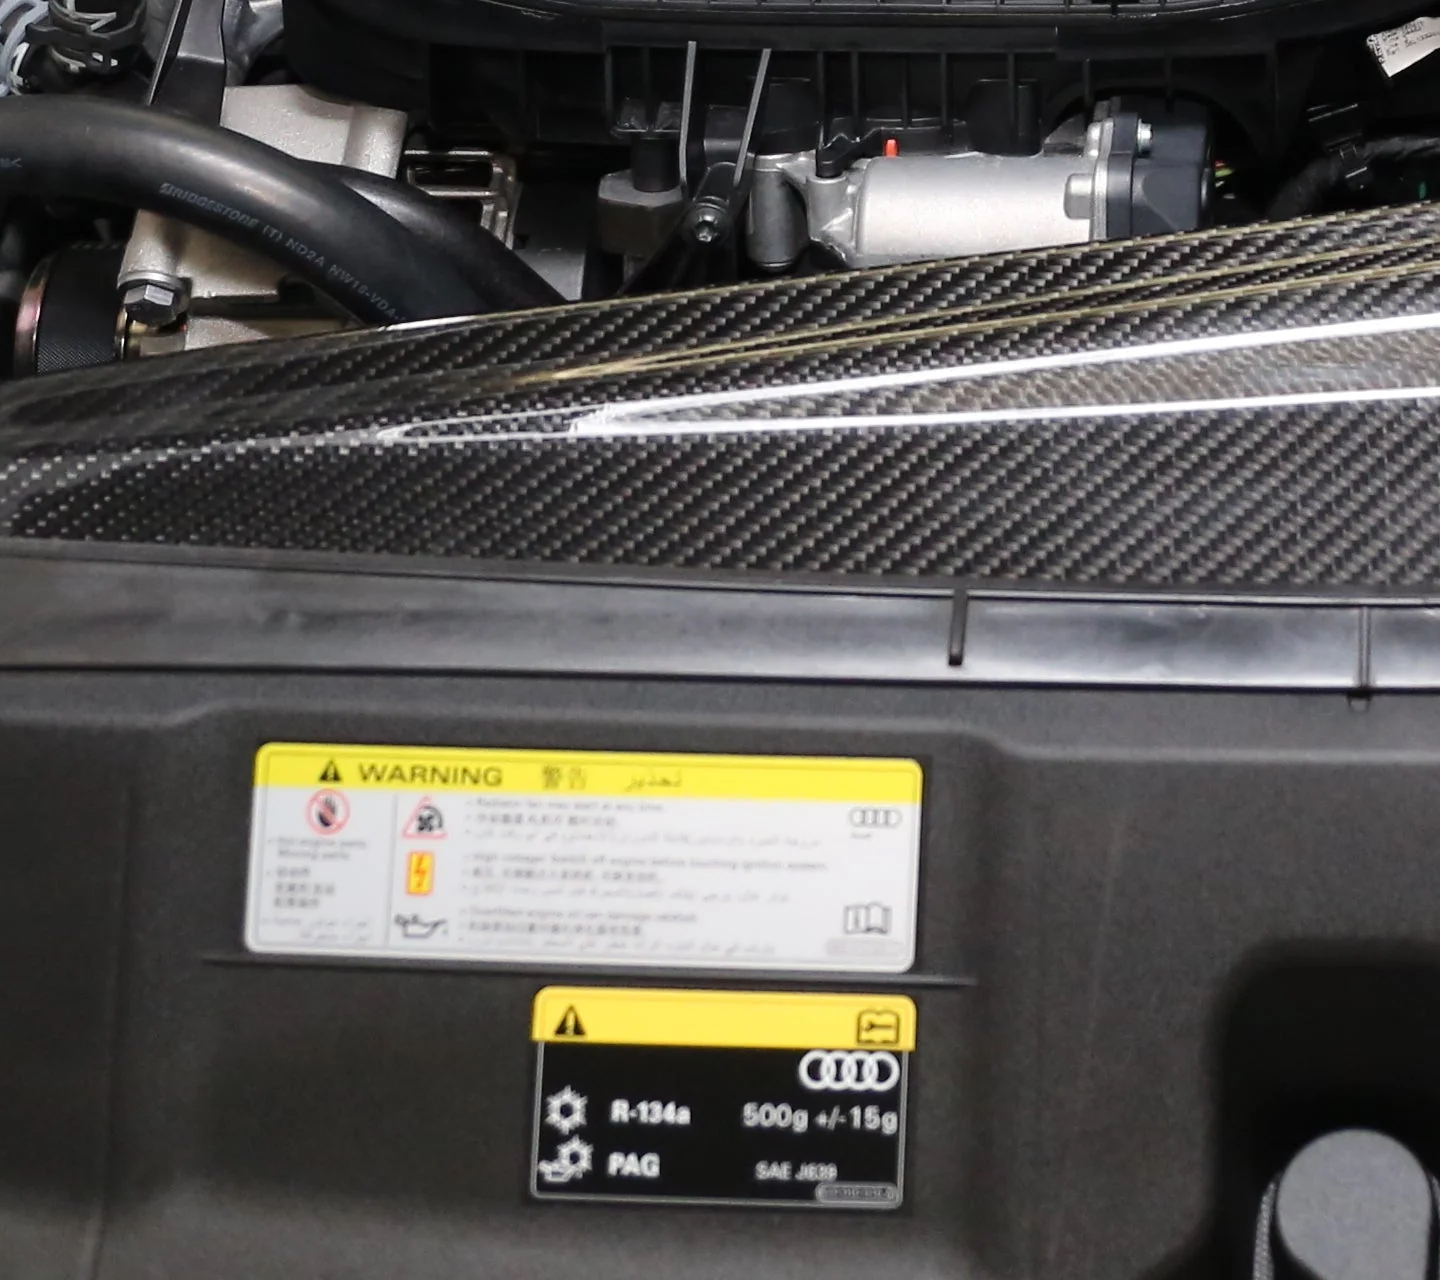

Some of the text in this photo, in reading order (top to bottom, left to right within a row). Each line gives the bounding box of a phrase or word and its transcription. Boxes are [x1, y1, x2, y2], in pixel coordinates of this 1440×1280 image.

[360, 763, 503, 788] WARNING
[609, 1099, 692, 1125] R-134a
[742, 1102, 809, 1133] 500g
[850, 1103, 899, 1136] 15g
[607, 1152, 660, 1179] PAG
[754, 1161, 791, 1182] SAE
